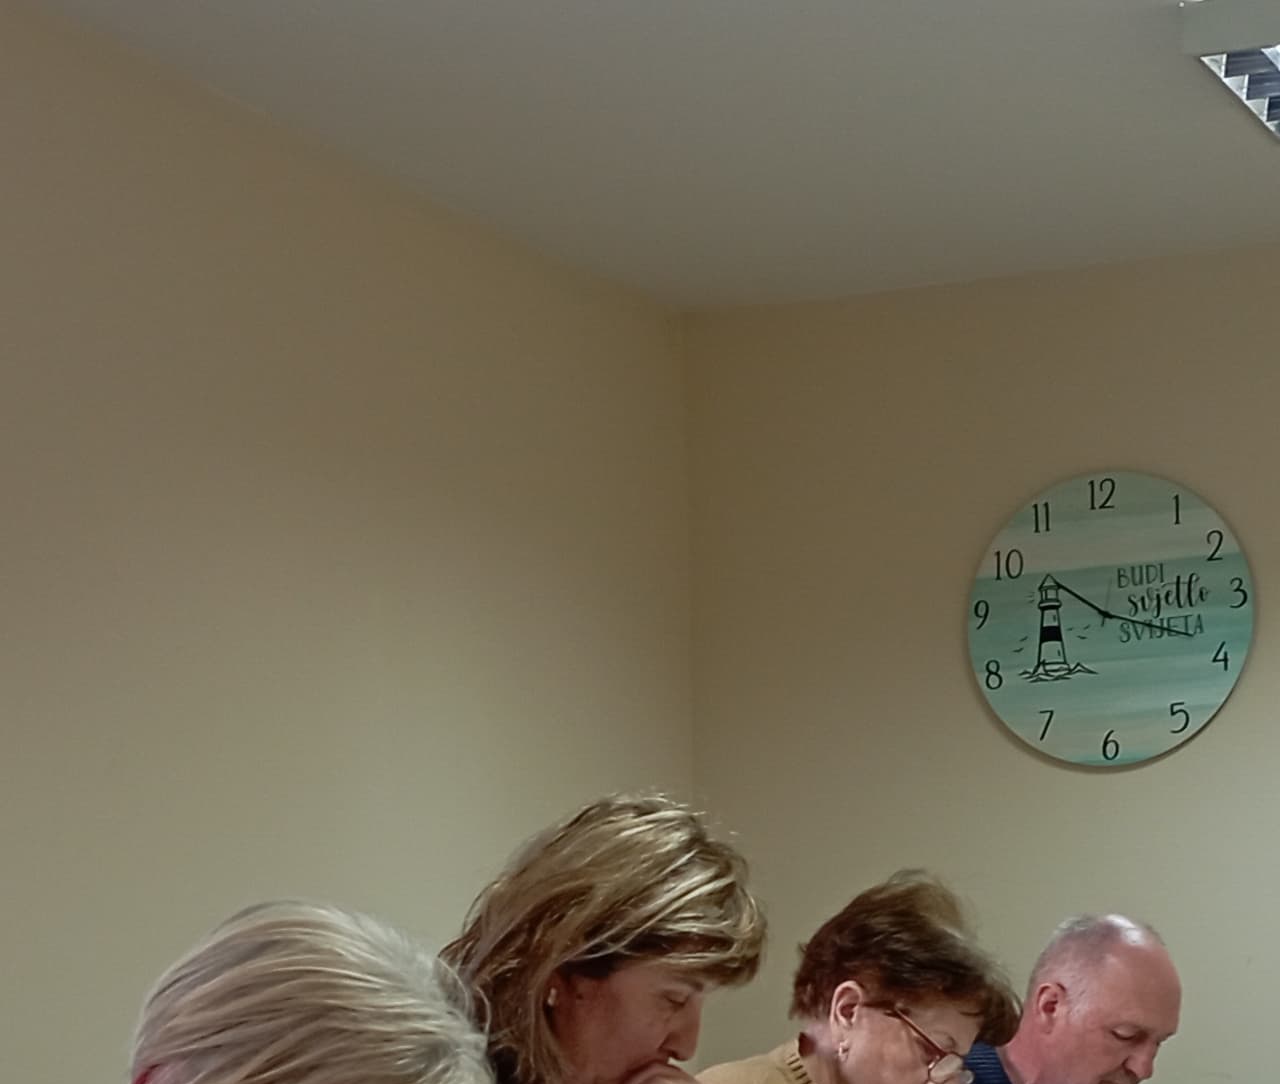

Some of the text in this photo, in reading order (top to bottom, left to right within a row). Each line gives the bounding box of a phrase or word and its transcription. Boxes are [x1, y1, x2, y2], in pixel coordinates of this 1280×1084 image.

[1087, 478, 1116, 511] 12
[1172, 494, 1181, 525] 1
[1032, 501, 1051, 533] 11
[1205, 530, 1224, 562] 2
[994, 548, 1024, 581] 10
[1117, 562, 1165, 589] BUDI
[1127, 572, 1211, 619] svjetlo
[1229, 577, 1249, 609] 3
[974, 599, 990, 630] 9
[1119, 613, 1205, 644] SVIJETA
[1211, 641, 1229, 671] 4
[985, 659, 1003, 690] 8
[1039, 710, 1055, 741] 7
[1170, 702, 1190, 734] 5
[1102, 729, 1120, 760] 6
